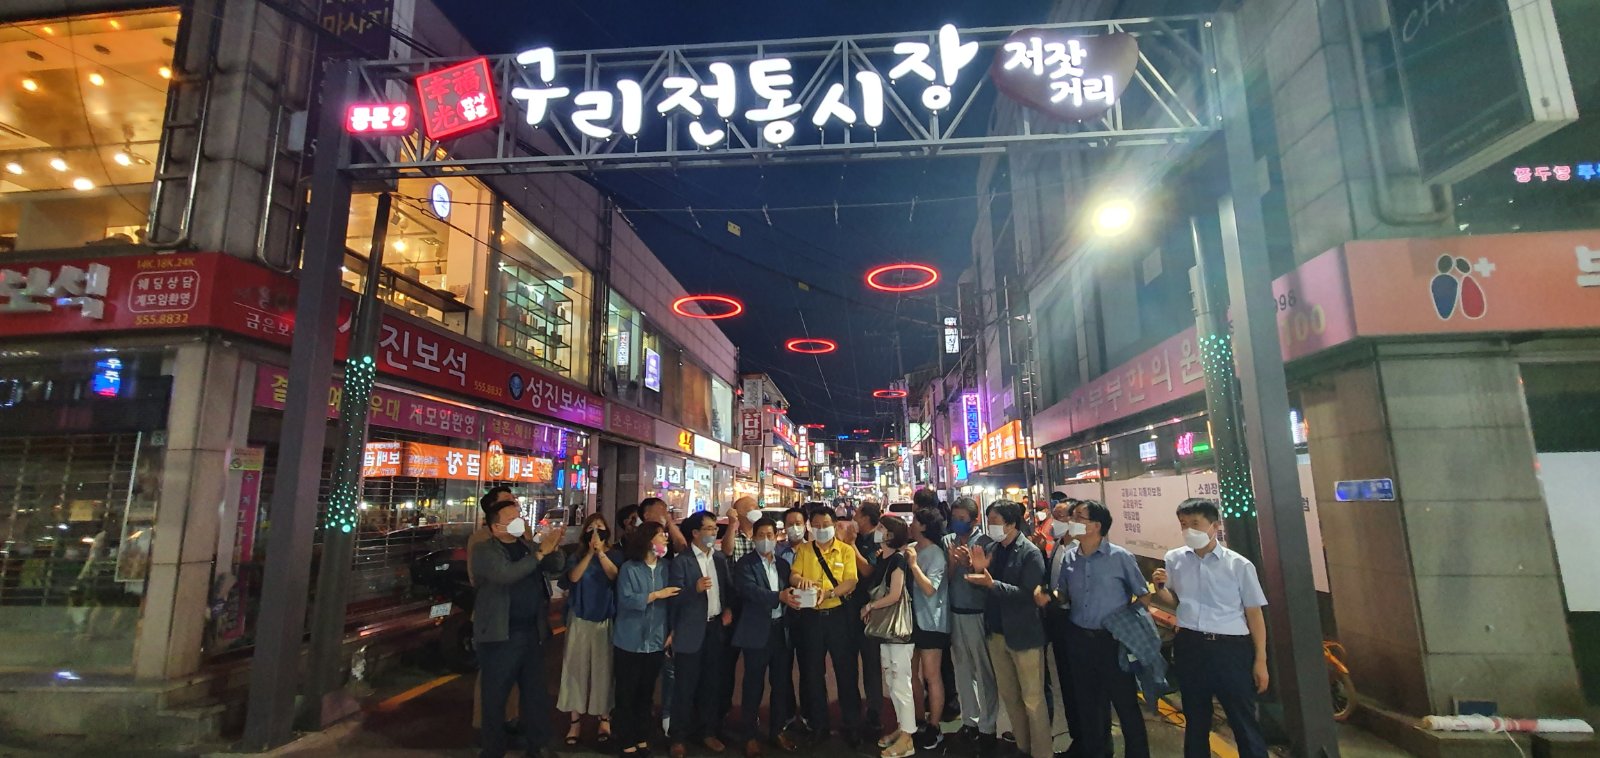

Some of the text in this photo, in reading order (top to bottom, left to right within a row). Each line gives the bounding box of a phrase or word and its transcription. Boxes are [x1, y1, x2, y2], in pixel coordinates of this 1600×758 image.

[1003, 36, 1087, 78] 저잣
[511, 23, 979, 145] 구리전통시장
[1049, 75, 1115, 107] 거리
[246, 312, 294, 337] 금은보
[526, 376, 587, 421] 성진보석
